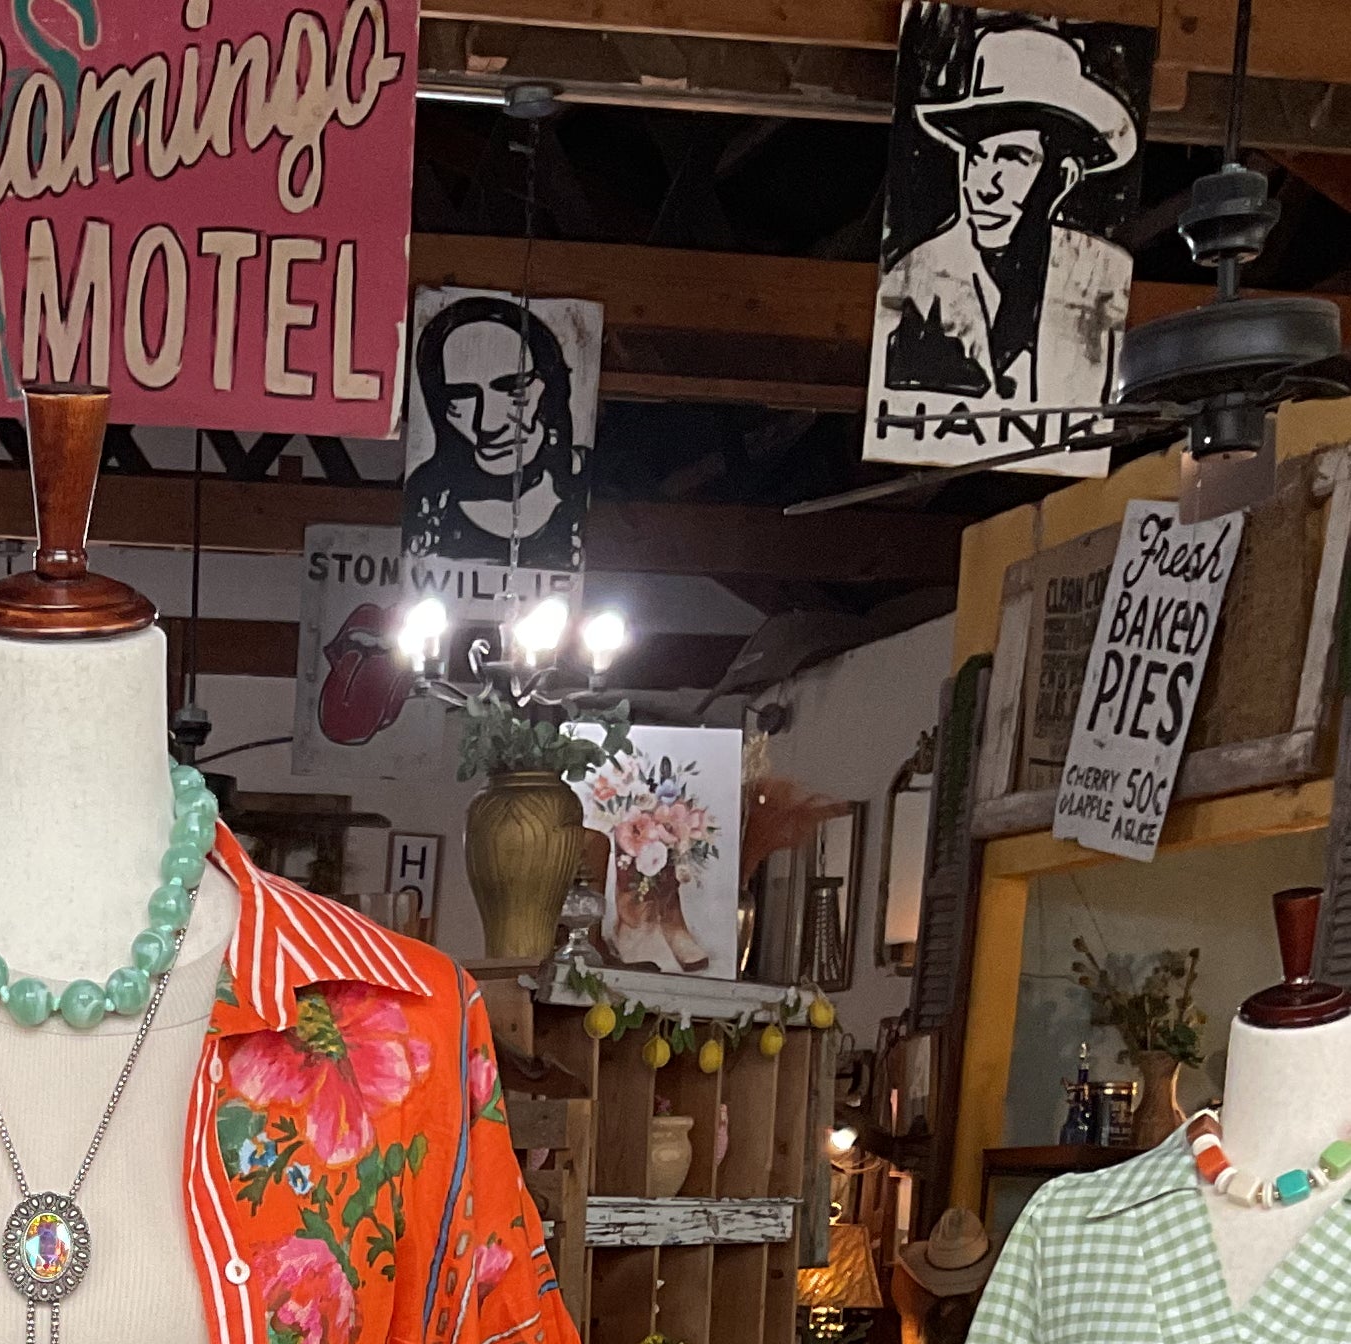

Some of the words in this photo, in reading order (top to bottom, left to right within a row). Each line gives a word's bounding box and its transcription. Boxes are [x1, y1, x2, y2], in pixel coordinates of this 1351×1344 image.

[21, 217, 383, 401] MOTEL
[876, 399, 1098, 449] HANK
[1123, 512, 1232, 589] Fresh
[1107, 591, 1210, 657] BAKED
[1086, 649, 1195, 747] PIES
[1065, 764, 1121, 793] CHERRY
